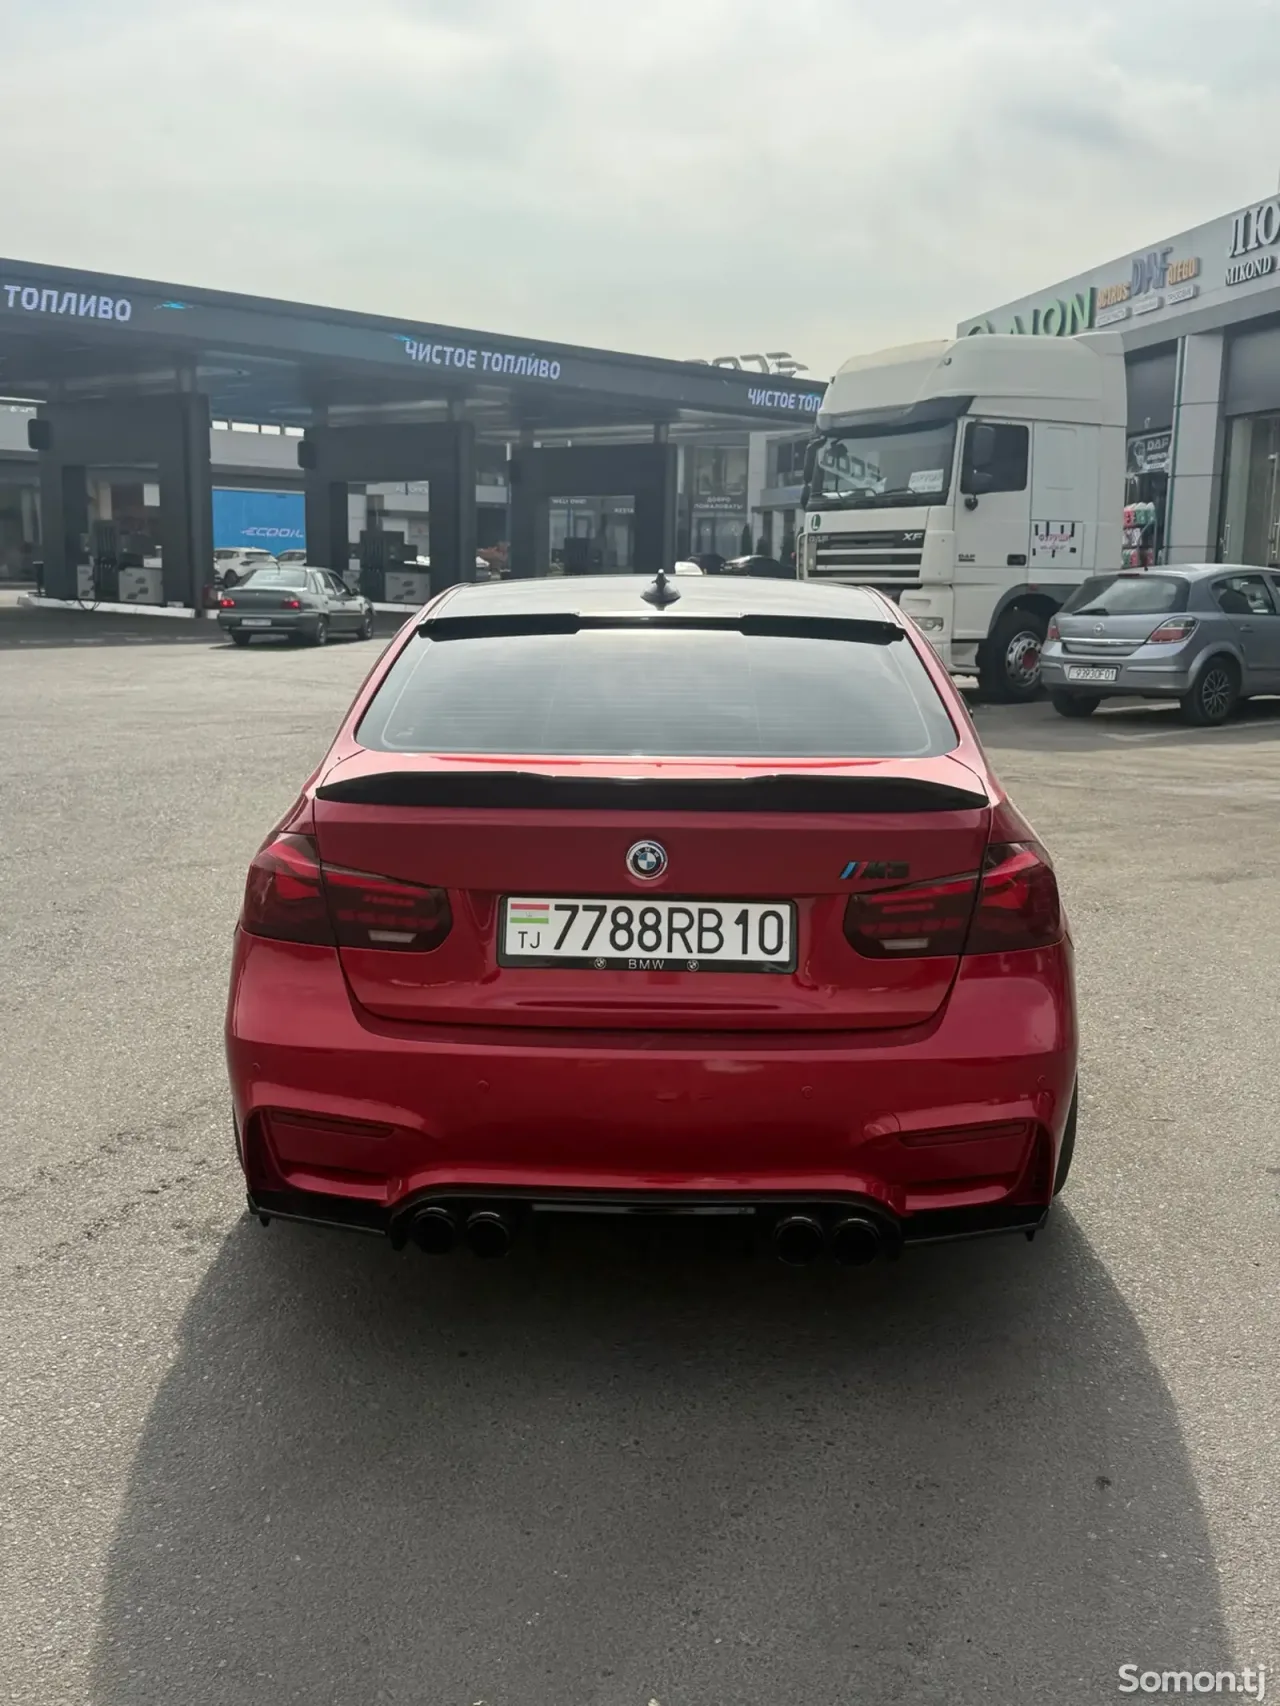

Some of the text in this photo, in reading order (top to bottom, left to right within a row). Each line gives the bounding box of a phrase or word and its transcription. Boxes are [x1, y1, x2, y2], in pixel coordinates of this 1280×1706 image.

[4, 284, 132, 322] ТОПЛИВО
[405, 340, 561, 380] ЧИСТОЕ ТОПЛИВО
[747, 388, 796, 409] ЧИСТОЕ
[902, 532, 924, 541] XF
[635, 847, 660, 858] BMW
[553, 903, 784, 956] 7788RB10
[518, 931, 541, 949] TJ
[628, 959, 665, 971] BMW
